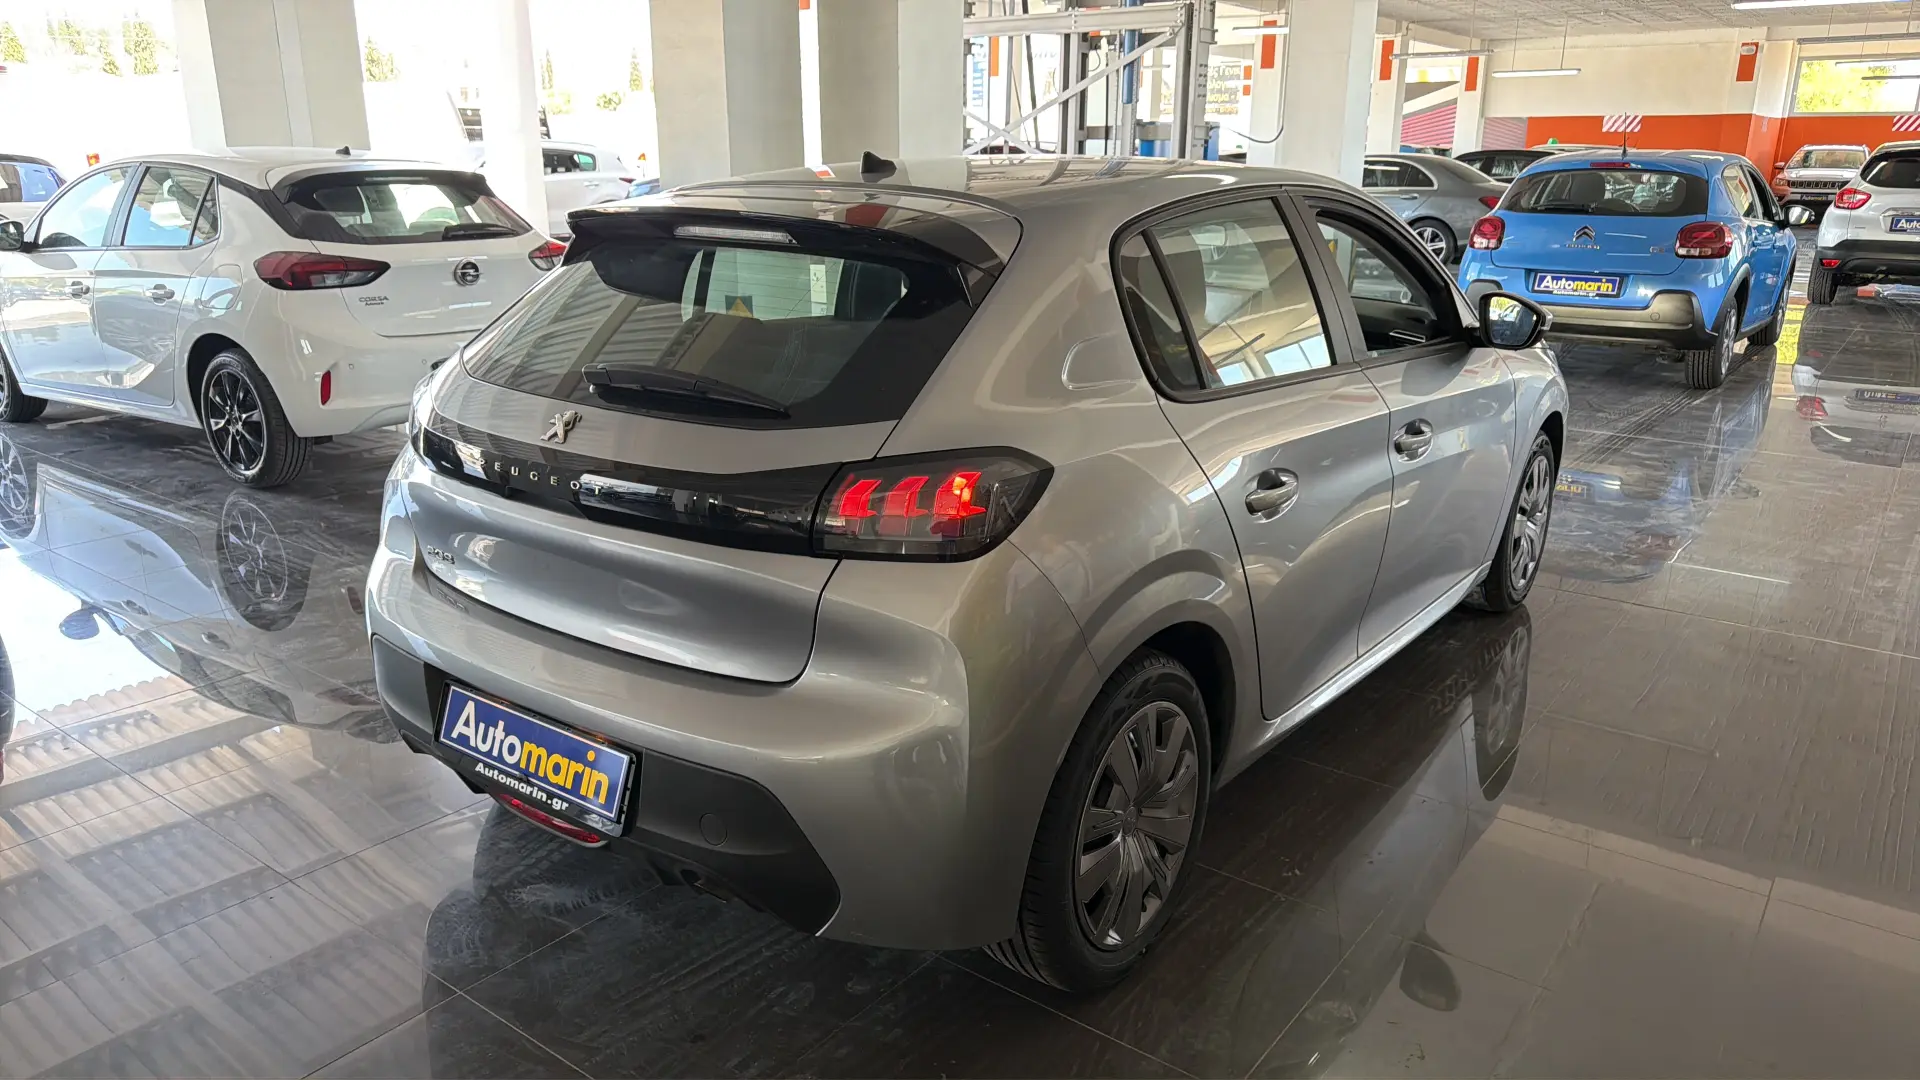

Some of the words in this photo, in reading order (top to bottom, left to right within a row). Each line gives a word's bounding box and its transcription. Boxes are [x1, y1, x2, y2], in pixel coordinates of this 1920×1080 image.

[1540, 275, 1613, 292] Automarin
[479, 458, 602, 495] PEUGEOT
[450, 699, 610, 805] Automarin
[474, 762, 570, 812] Automarin.gr
